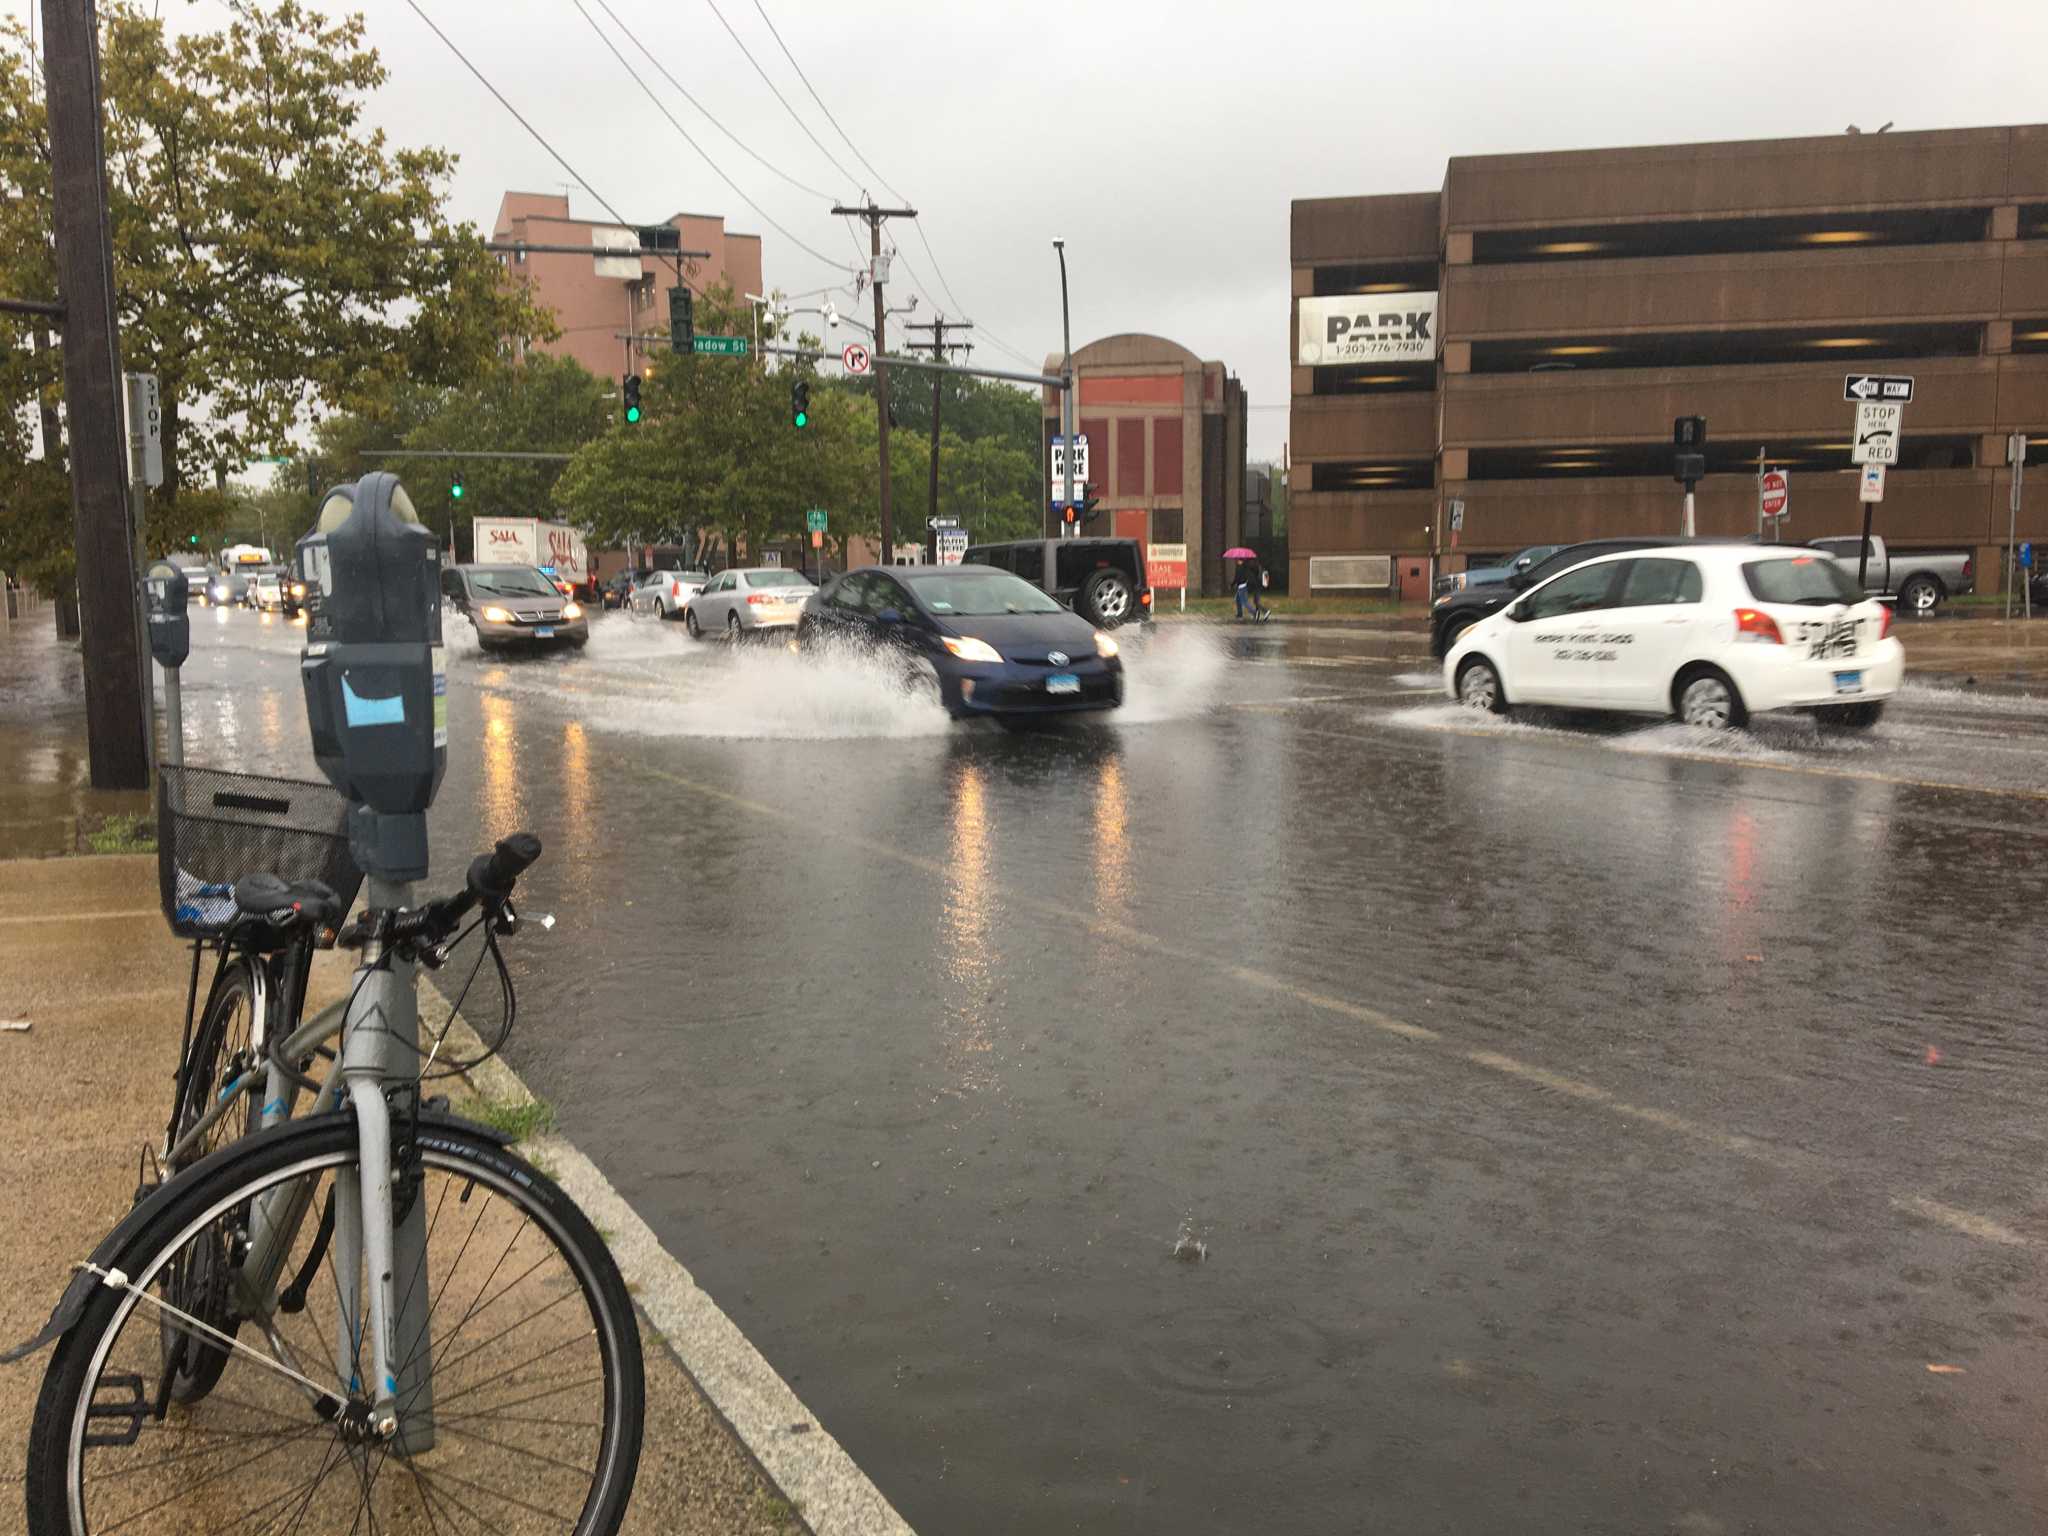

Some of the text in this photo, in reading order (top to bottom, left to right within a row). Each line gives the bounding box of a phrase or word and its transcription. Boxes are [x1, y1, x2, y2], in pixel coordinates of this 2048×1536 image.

[1327, 312, 1432, 343] PARK
[732, 340, 745, 351] St
[1858, 383, 1903, 394] ONE WAY
[147, 379, 158, 437] STOP
[1864, 407, 1896, 419] STOP
[1054, 448, 1085, 460] PRK
[1868, 447, 1893, 459] RED
[1056, 463, 1084, 475] HRE
